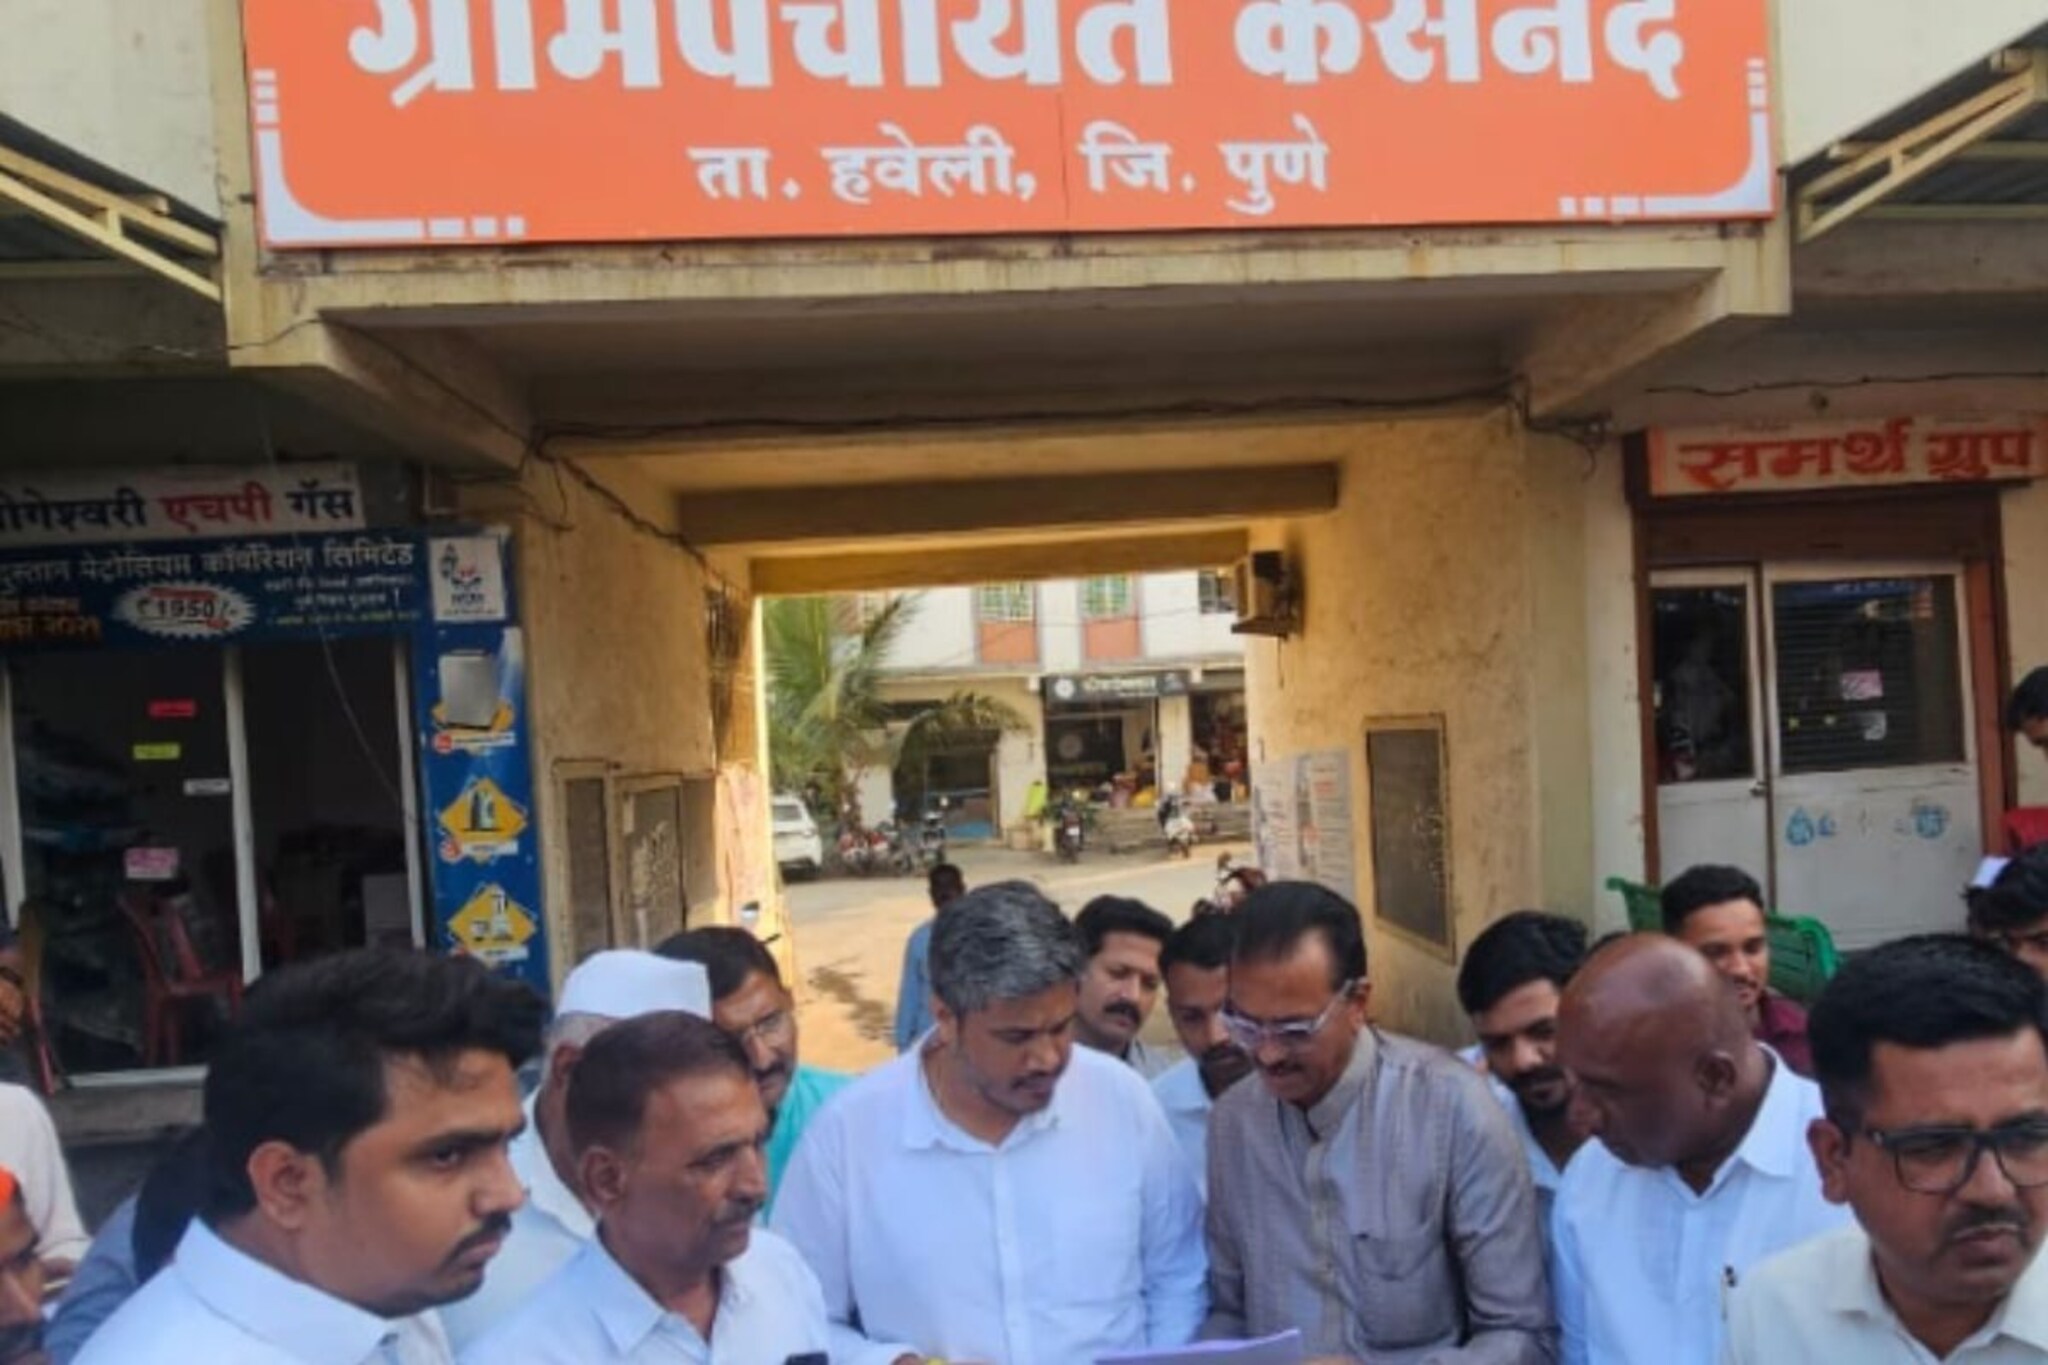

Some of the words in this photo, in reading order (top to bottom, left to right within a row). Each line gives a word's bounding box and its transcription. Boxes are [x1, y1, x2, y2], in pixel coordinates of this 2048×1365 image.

[688, 147, 801, 199] ता.
[821, 121, 1037, 204] हवेली,
[1078, 119, 1195, 192] जि.
[1219, 113, 1330, 216] पुणे
[1678, 416, 1914, 491] समर्थ
[1926, 429, 2036, 481] ग्रुप
[0, 486, 147, 532] ोगेश्वरी
[158, 480, 273, 533] एचपी
[286, 479, 355, 519] गॅस
[323, 537, 415, 568] लिमिटेड
